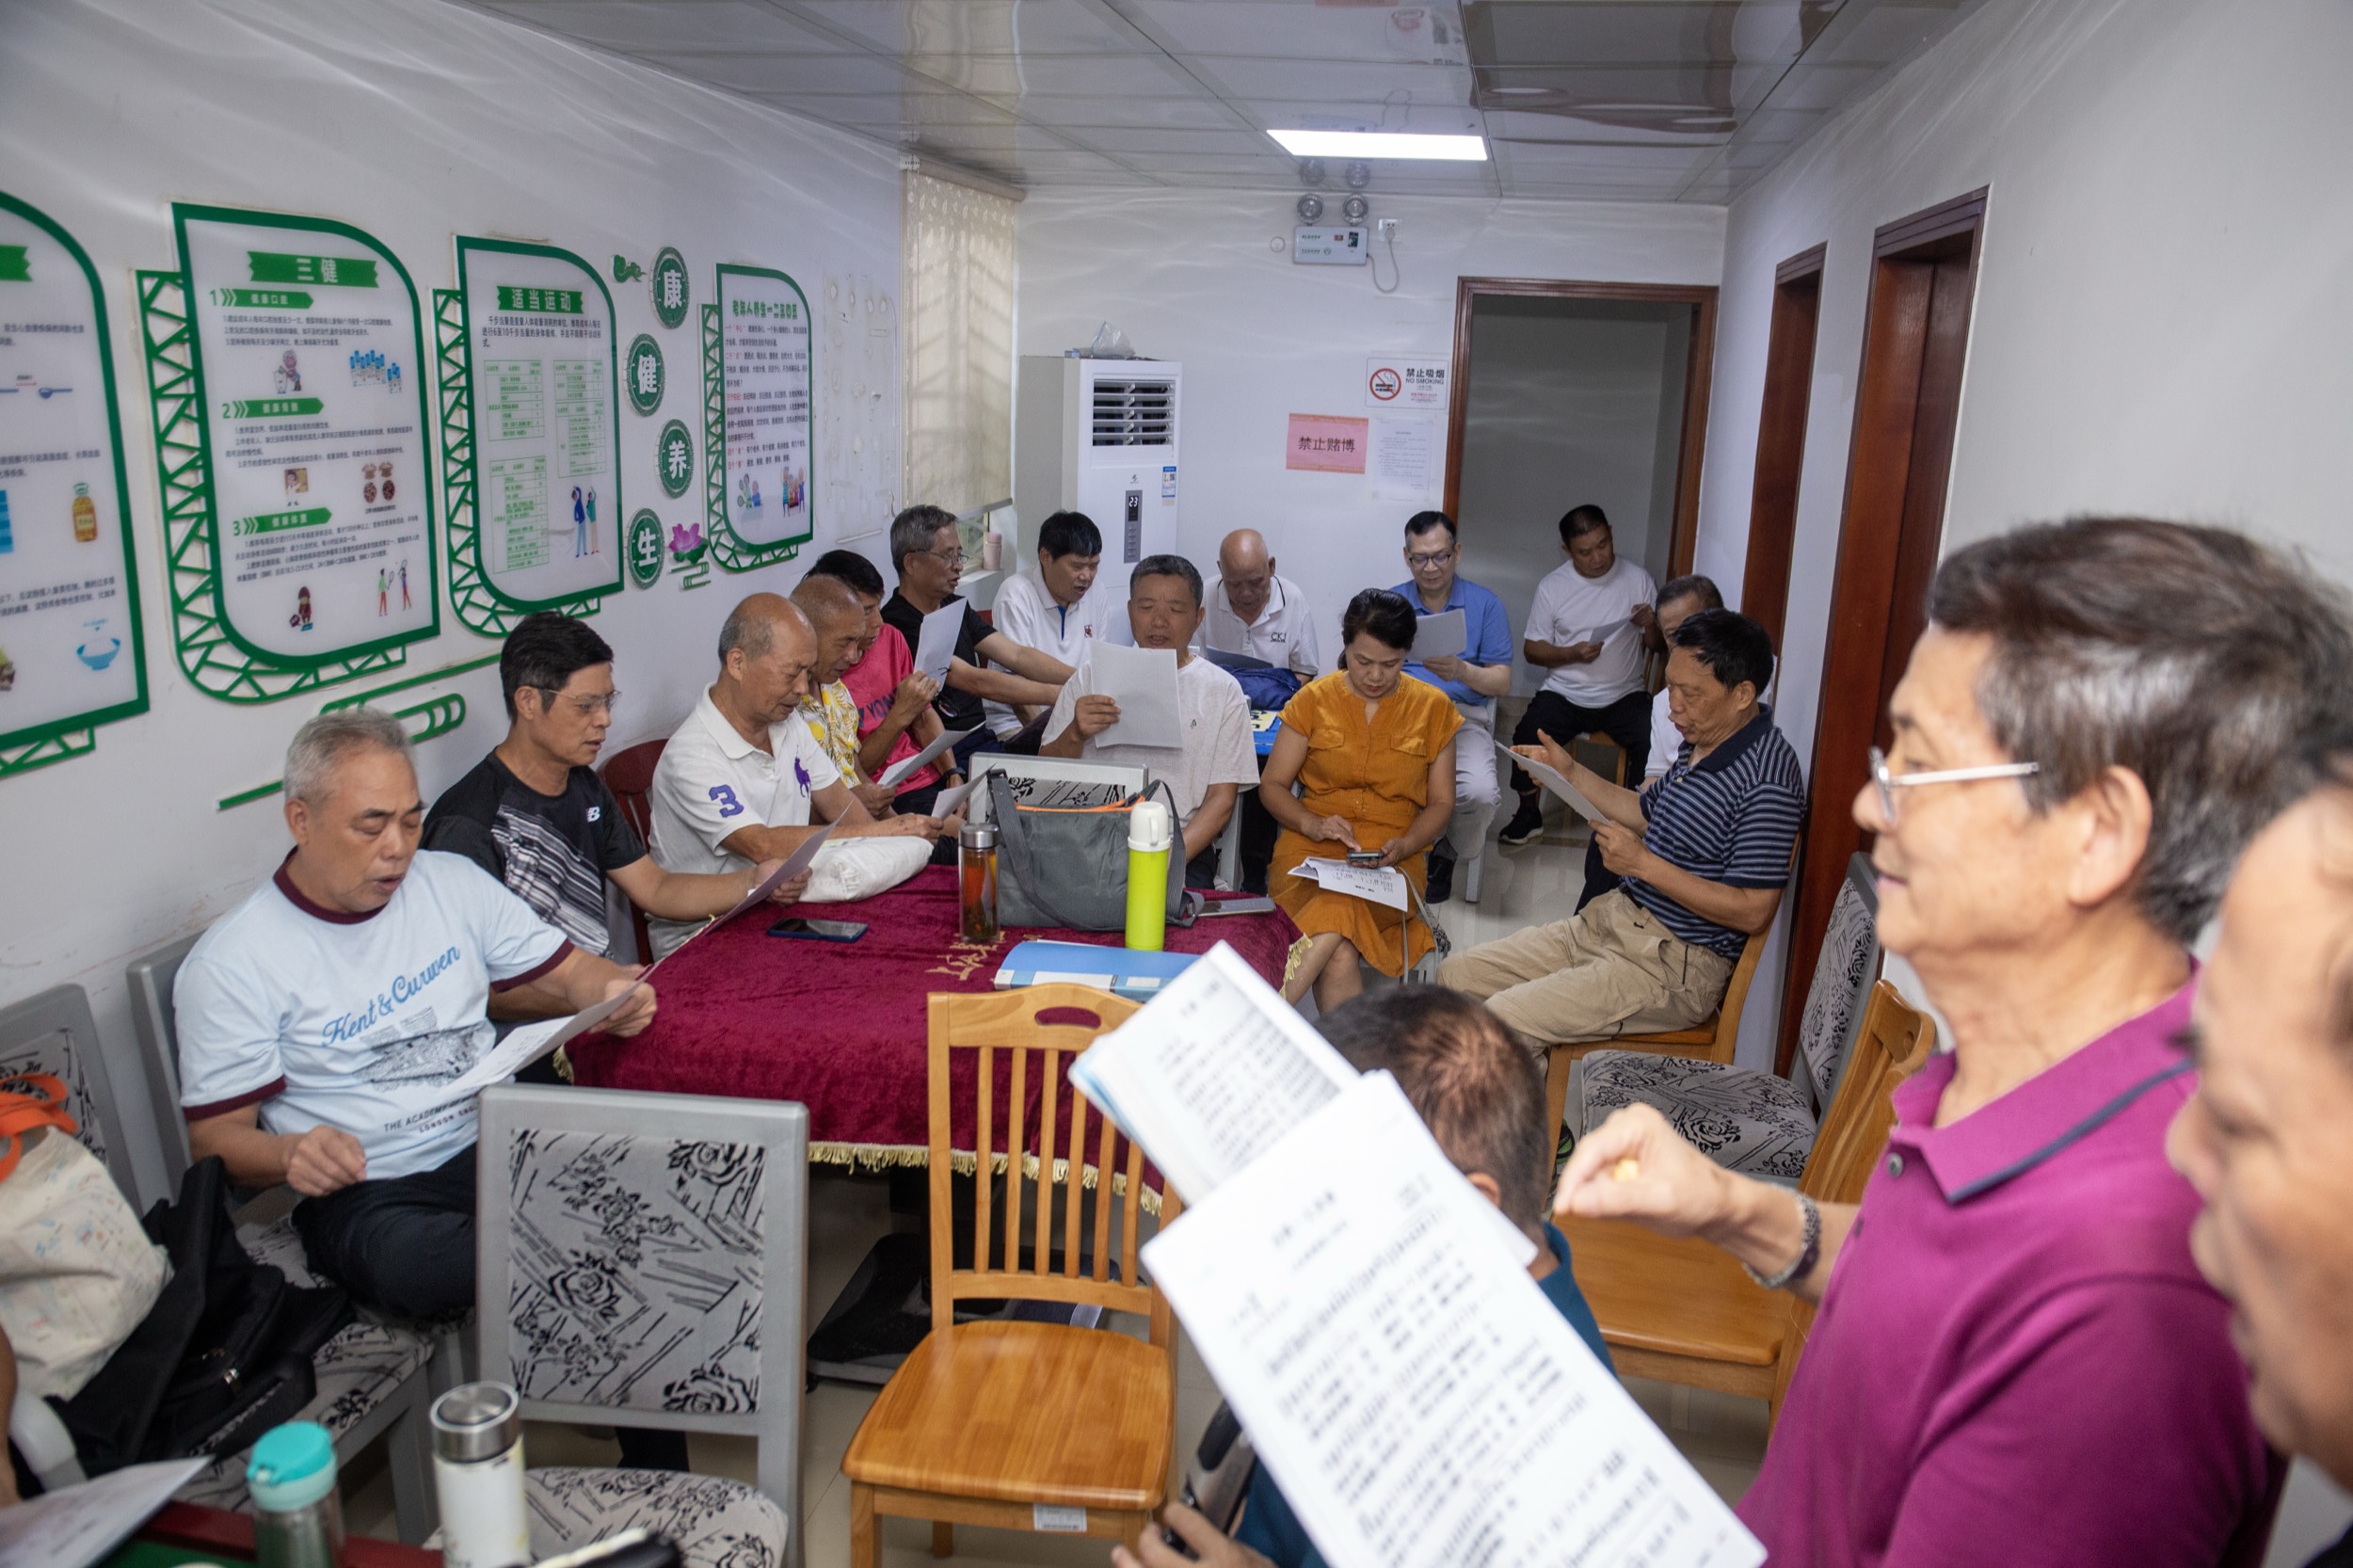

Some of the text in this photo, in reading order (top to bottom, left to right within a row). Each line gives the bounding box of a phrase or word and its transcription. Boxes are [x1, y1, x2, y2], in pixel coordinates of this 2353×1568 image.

[296, 256, 340, 283] 三健
[209, 289, 217, 307] 1
[512, 288, 571, 312] 适当运动
[664, 269, 682, 309] 康
[732, 299, 798, 320] 老年人养生一二三四五
[637, 354, 658, 395] 健
[1406, 367, 1445, 379] 禁止吸烟
[221, 403, 231, 419] 2
[1298, 436, 1356, 454] 禁止赌博
[668, 440, 687, 479] 养
[1128, 496, 1139, 507] 23
[232, 520, 241, 536] 3
[637, 527, 658, 567] 生
[708, 784, 744, 818] 3
[321, 946, 460, 1048] Kent & Curwen
[384, 1119, 403, 1132] THE
